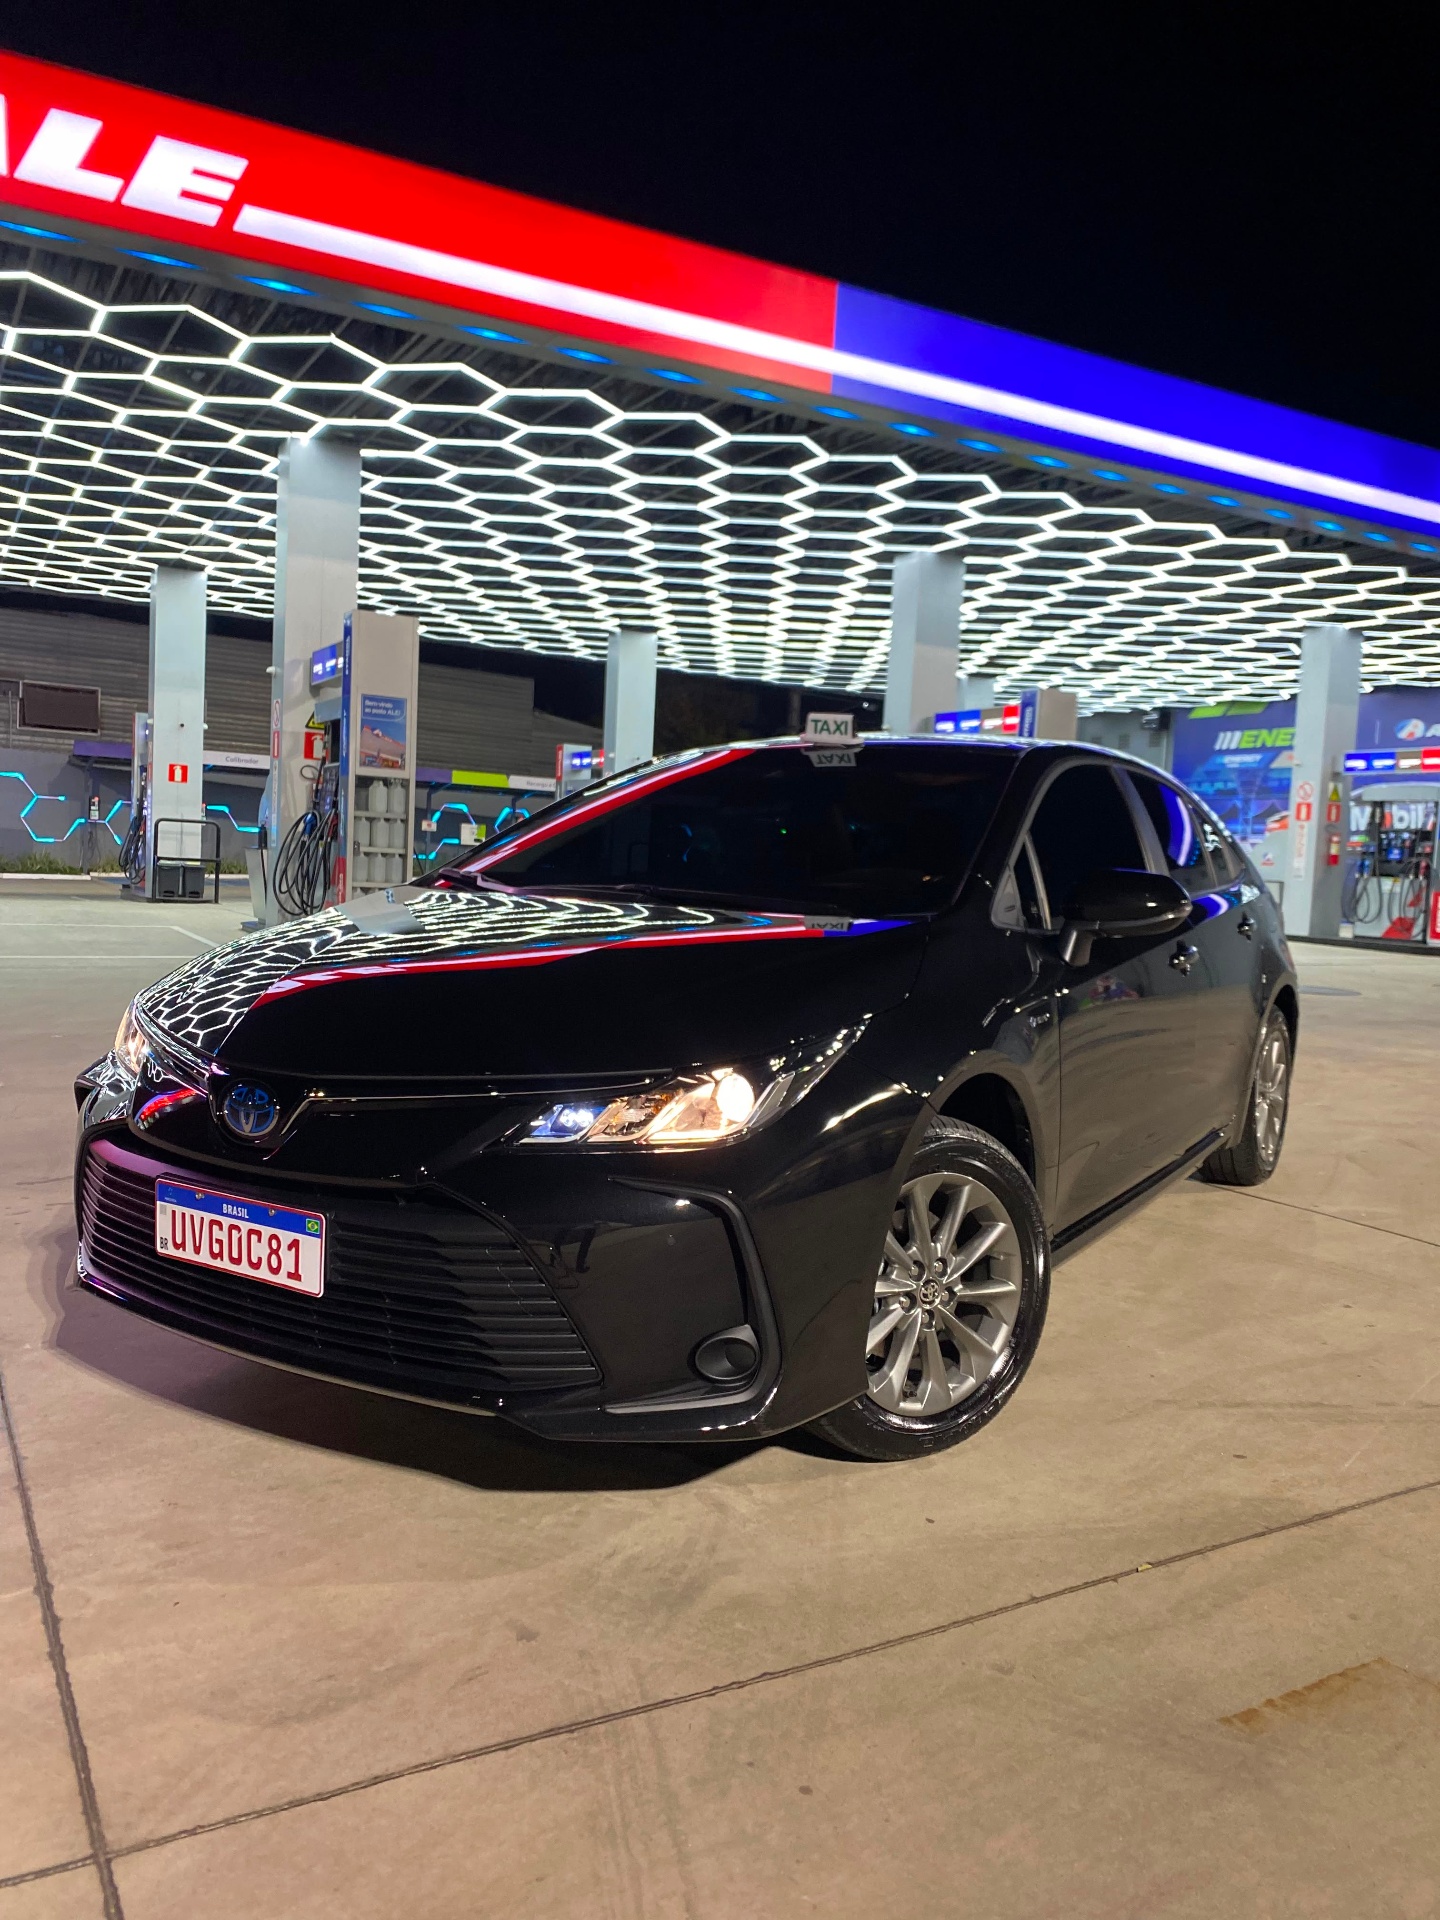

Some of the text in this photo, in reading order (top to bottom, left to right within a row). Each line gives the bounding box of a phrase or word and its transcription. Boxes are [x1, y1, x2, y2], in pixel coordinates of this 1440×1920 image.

[0, 92, 249, 227] LE
[811, 719, 849, 736] TAXI
[225, 755, 259, 764] Calibrador
[222, 1203, 249, 1219] BRASIL
[159, 1236, 169, 1250] BR
[171, 1209, 302, 1282] UVG0C81
